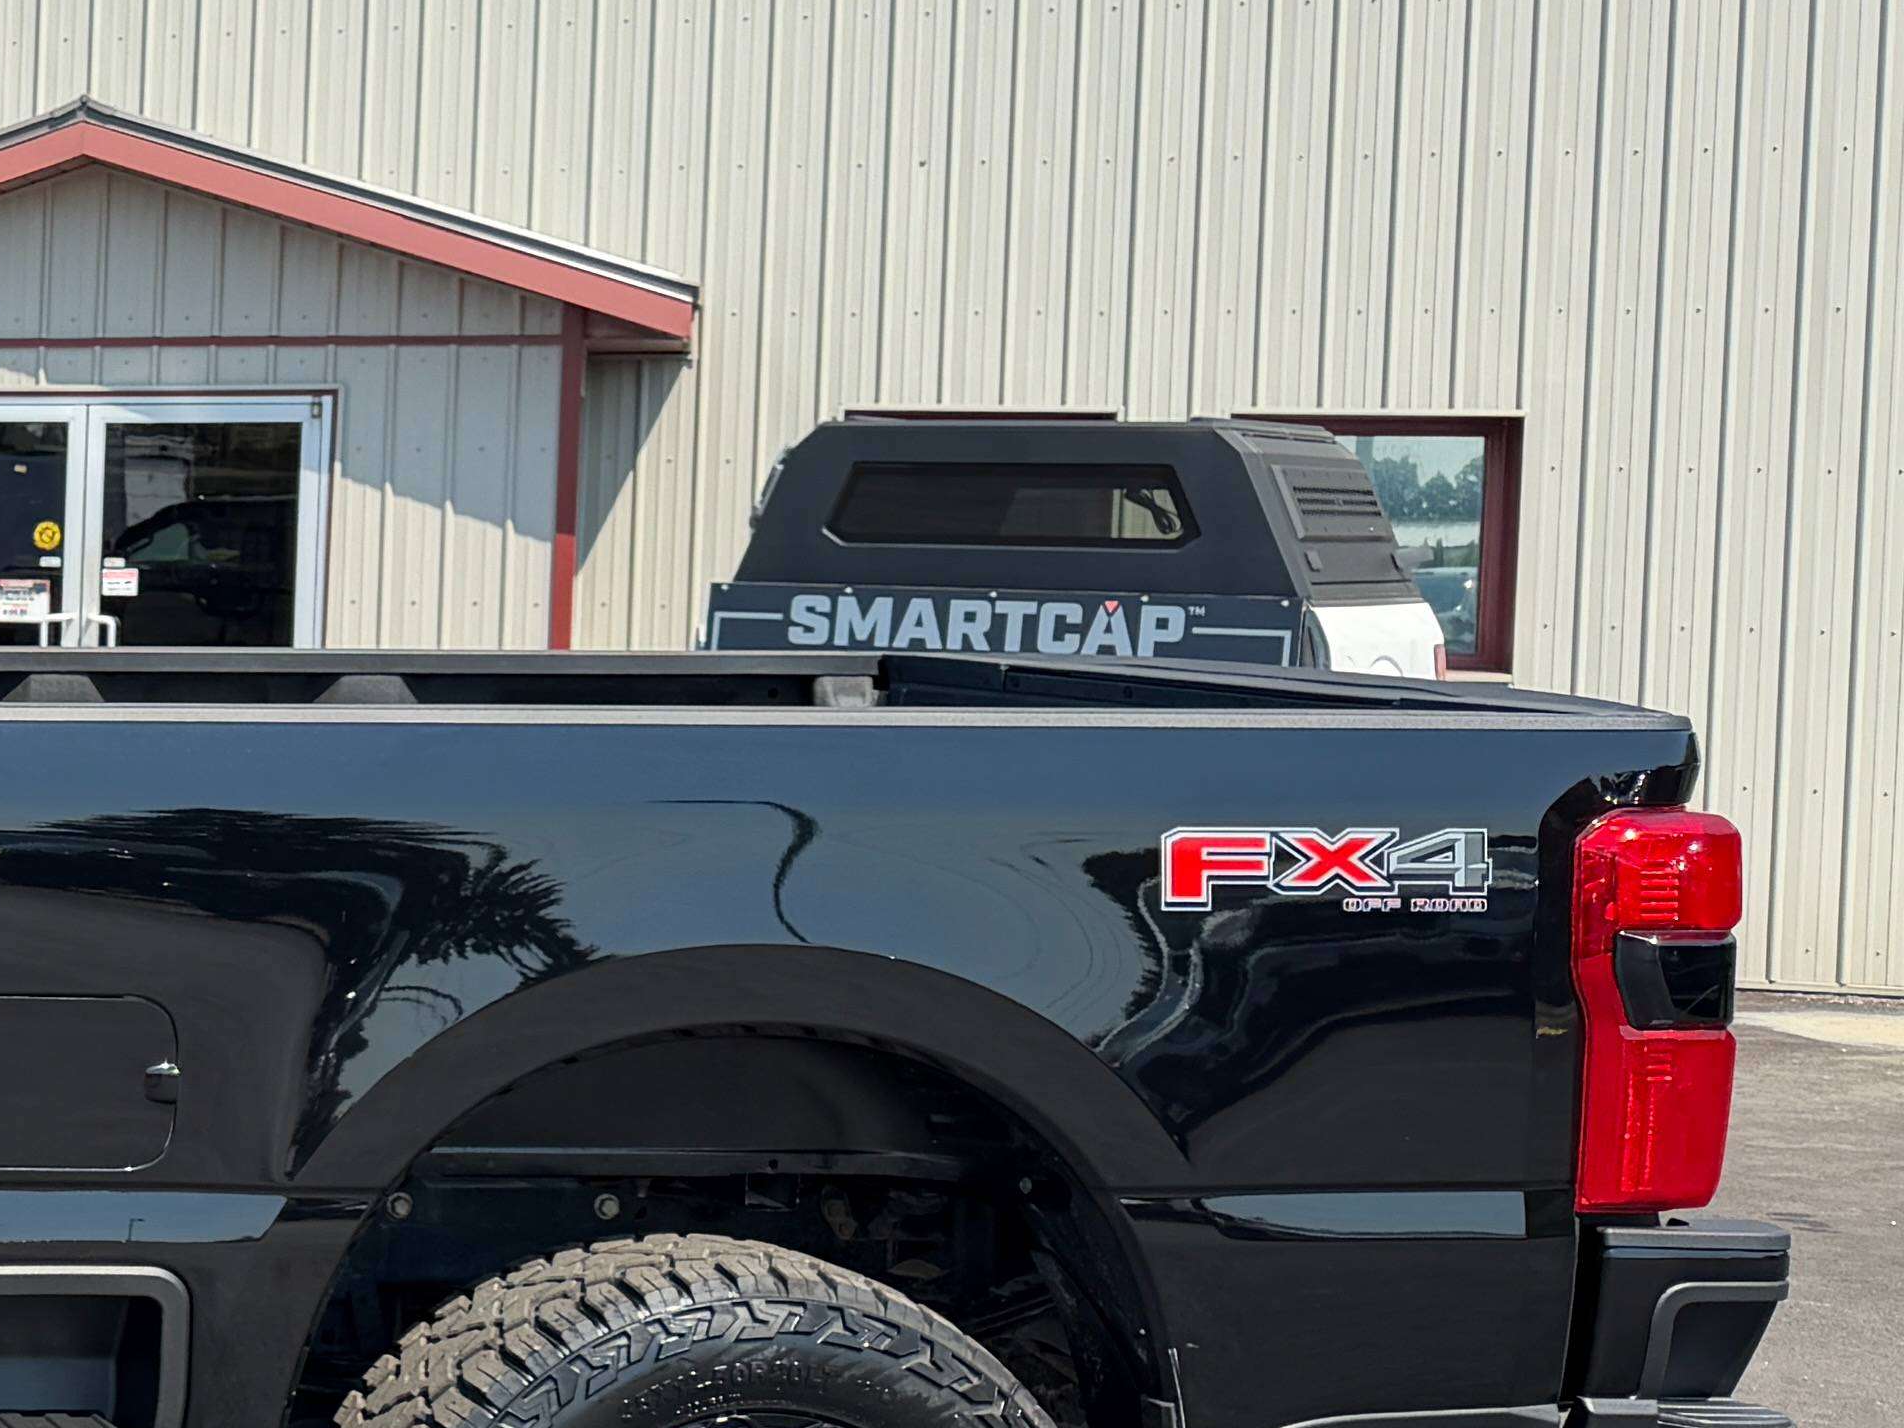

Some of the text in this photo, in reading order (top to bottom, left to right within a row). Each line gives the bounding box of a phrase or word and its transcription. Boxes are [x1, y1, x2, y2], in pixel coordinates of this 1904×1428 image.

[788, 594, 1186, 657] SMARTCAP
[1161, 828, 1492, 912] FX4
[1343, 898, 1488, 913] OFF ROAD
